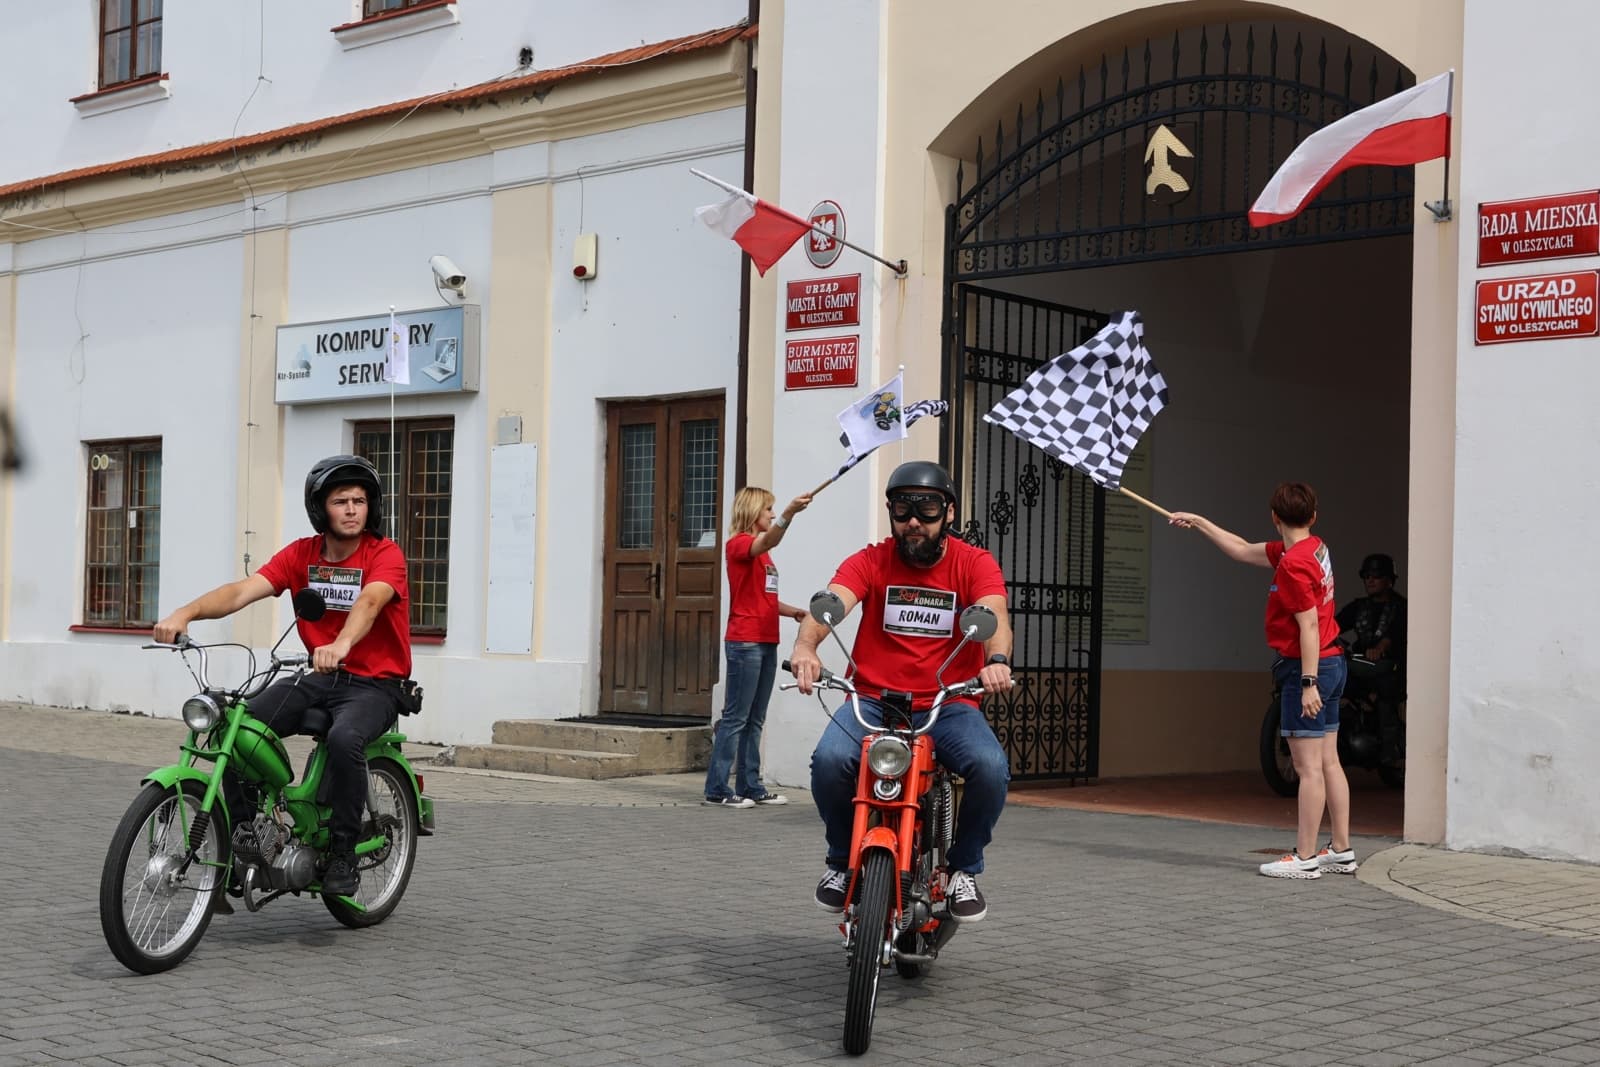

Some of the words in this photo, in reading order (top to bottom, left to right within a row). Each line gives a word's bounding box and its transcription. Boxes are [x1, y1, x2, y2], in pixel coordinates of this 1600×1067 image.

[1481, 212, 1518, 238] RADA
[1525, 203, 1598, 233] MIEJSKA
[1501, 241, 1511, 255] W
[1513, 235, 1574, 254] OLESZYCACH
[805, 282, 839, 294] URZĄD
[1497, 278, 1577, 301] URZĄD
[788, 295, 816, 313] MIASTA
[818, 295, 822, 310] I
[825, 292, 856, 309] GMINY
[1479, 302, 1518, 324] STANU
[1521, 296, 1593, 320] CYWILNEGO
[800, 313, 806, 324] W
[807, 310, 844, 324] OLESZYCACH
[1494, 324, 1506, 335] W
[1509, 319, 1579, 334] OLESZYCACH
[316, 322, 433, 354] KOMPURY
[787, 342, 856, 359] BURMISTRZ
[338, 361, 386, 386] SERW
[787, 358, 815, 373] MIASTA
[817, 357, 821, 371] I
[823, 355, 855, 371] GMINY
[914, 597, 944, 606] KOMARA
[898, 610, 940, 625] ROMAN
